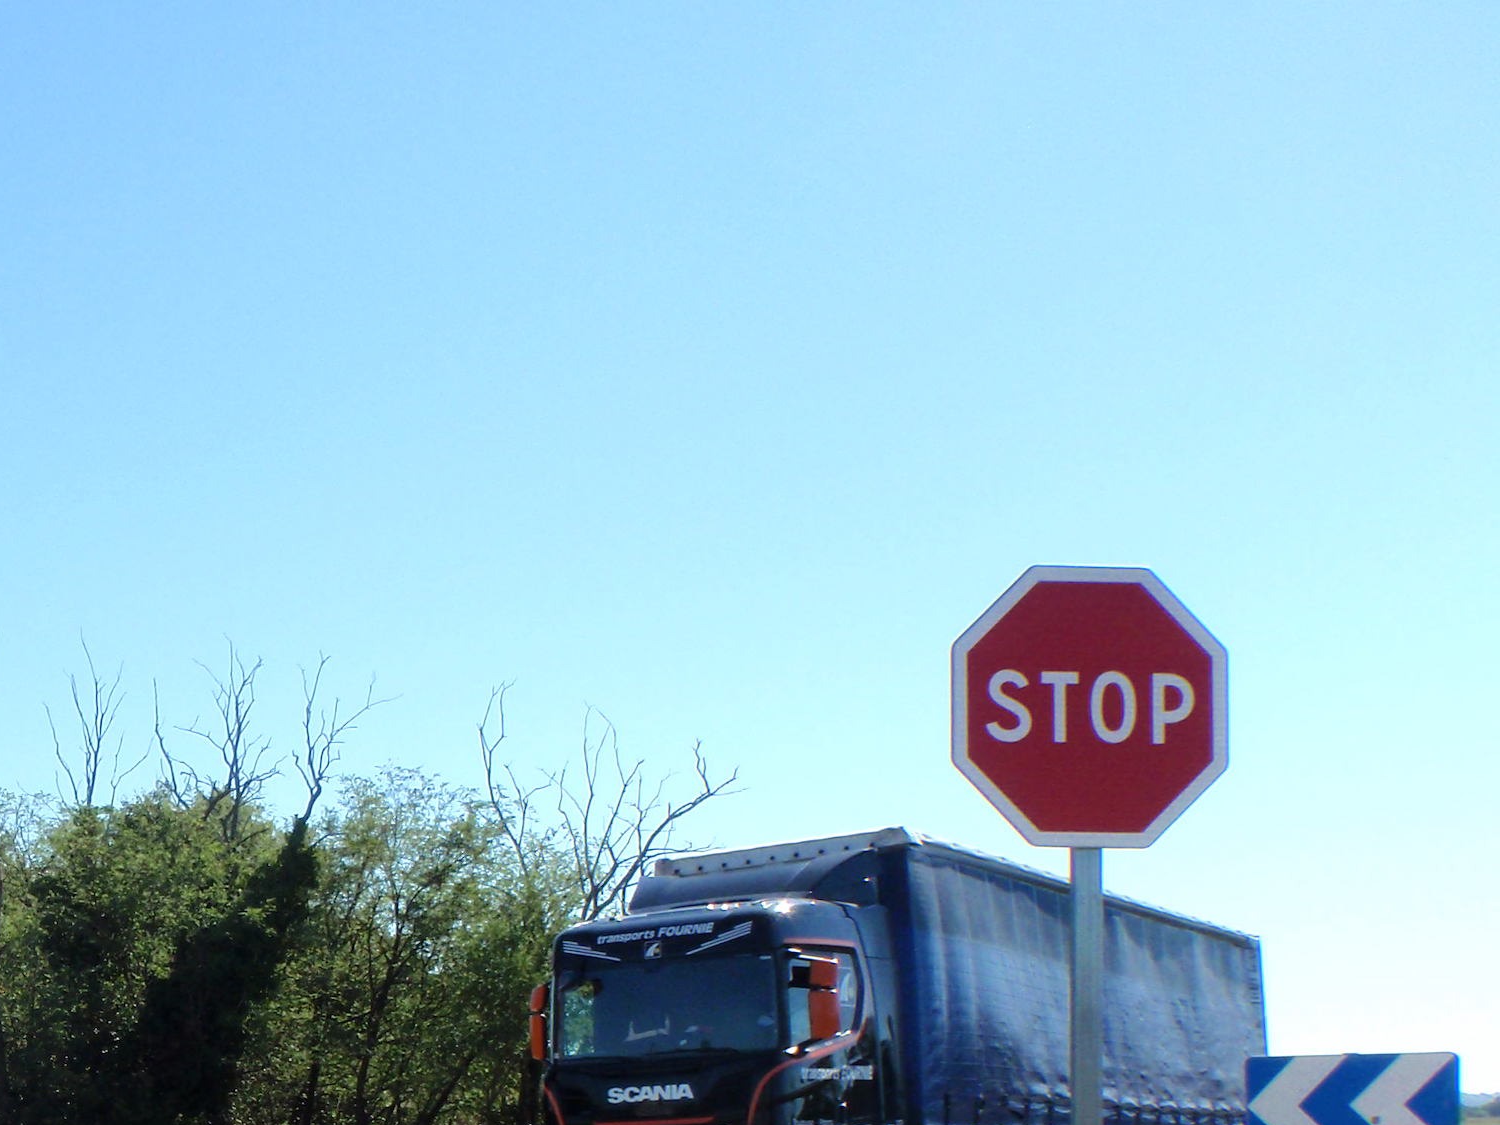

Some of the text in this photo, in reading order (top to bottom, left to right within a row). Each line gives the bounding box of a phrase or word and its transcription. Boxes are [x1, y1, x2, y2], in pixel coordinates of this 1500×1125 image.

[985, 669, 1195, 745] STOP
[597, 922, 715, 945] transports FOURNIE
[607, 1083, 695, 1104] SCANIA
